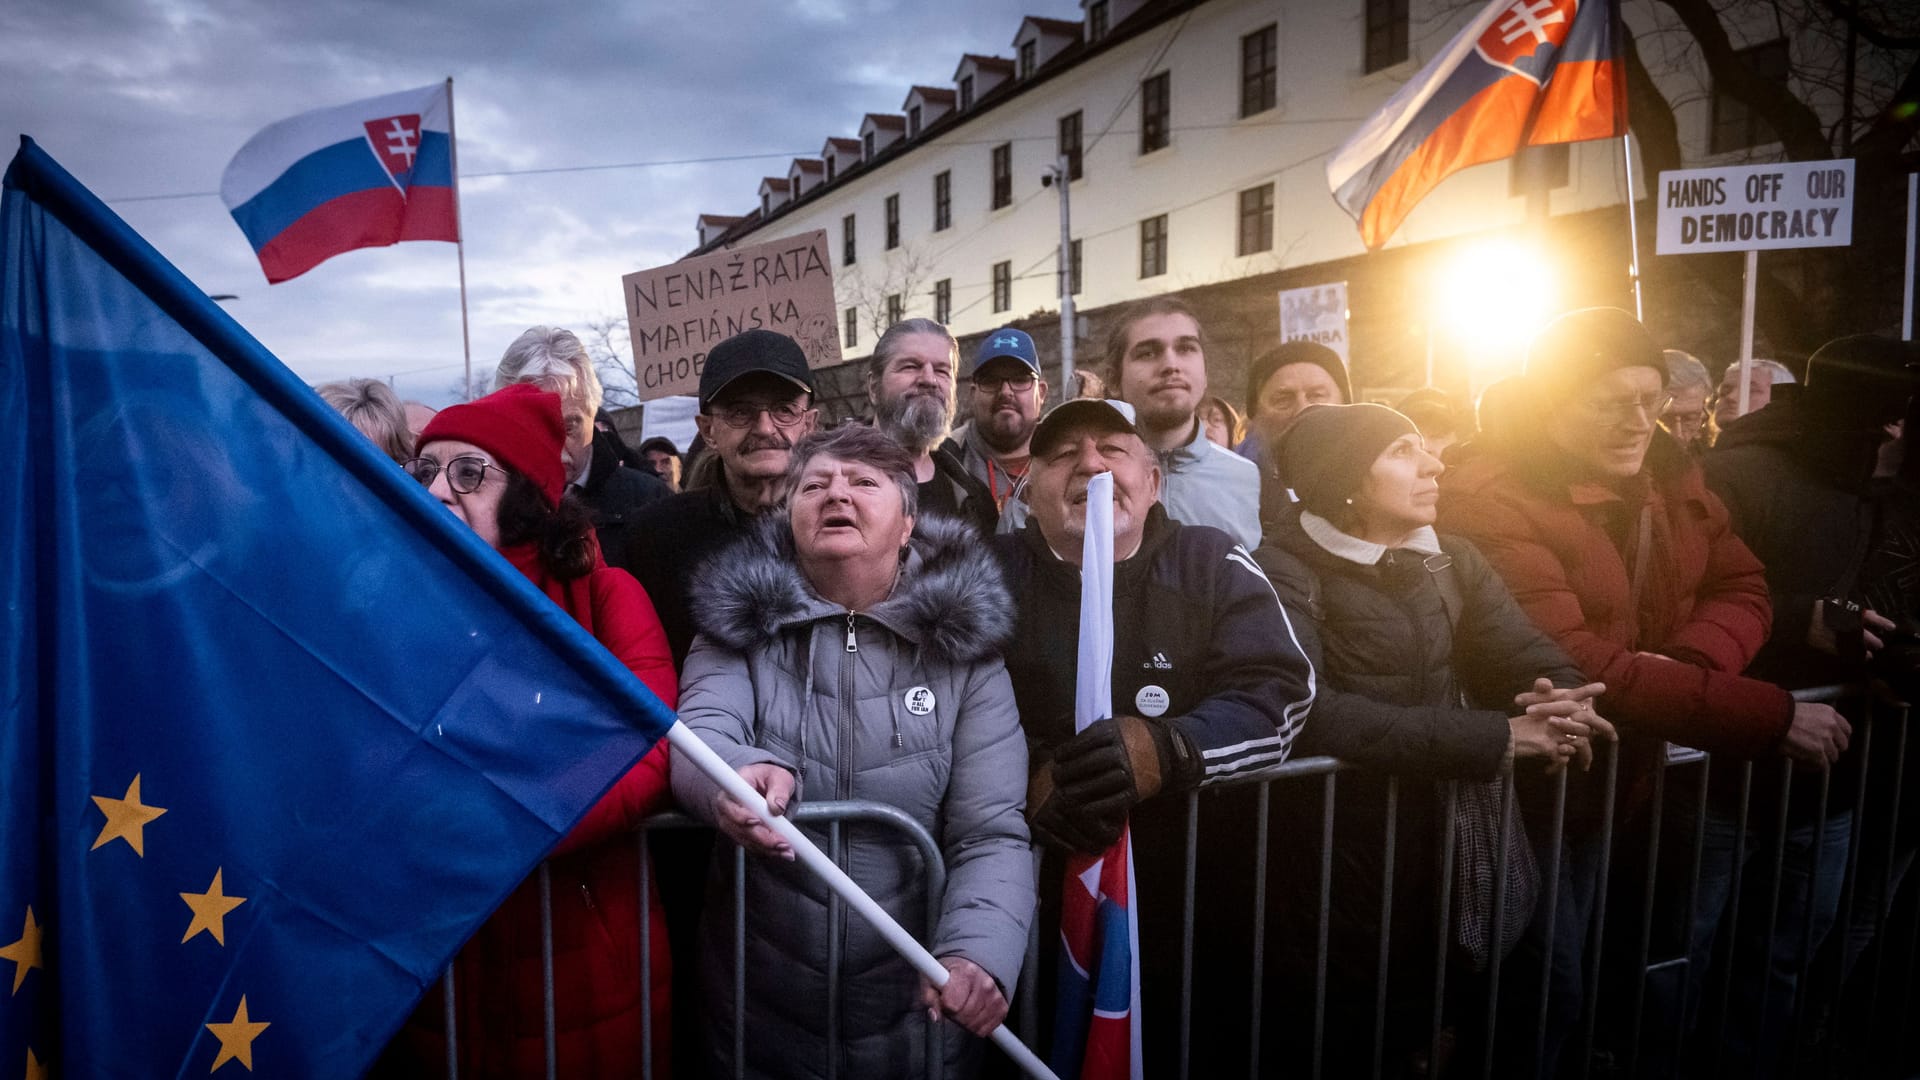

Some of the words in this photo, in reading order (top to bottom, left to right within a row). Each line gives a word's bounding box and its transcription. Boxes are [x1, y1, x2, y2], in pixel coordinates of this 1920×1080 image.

[1667, 178, 1727, 209] HANDS
[1745, 173, 1785, 204] OFF
[1806, 169, 1846, 200] OUR
[1680, 207, 1840, 245] DEMOCRACY
[634, 232, 829, 318] NENAŽRATÁ
[639, 298, 800, 356] MAFIÁNSKA
[643, 352, 707, 389] CHOB
